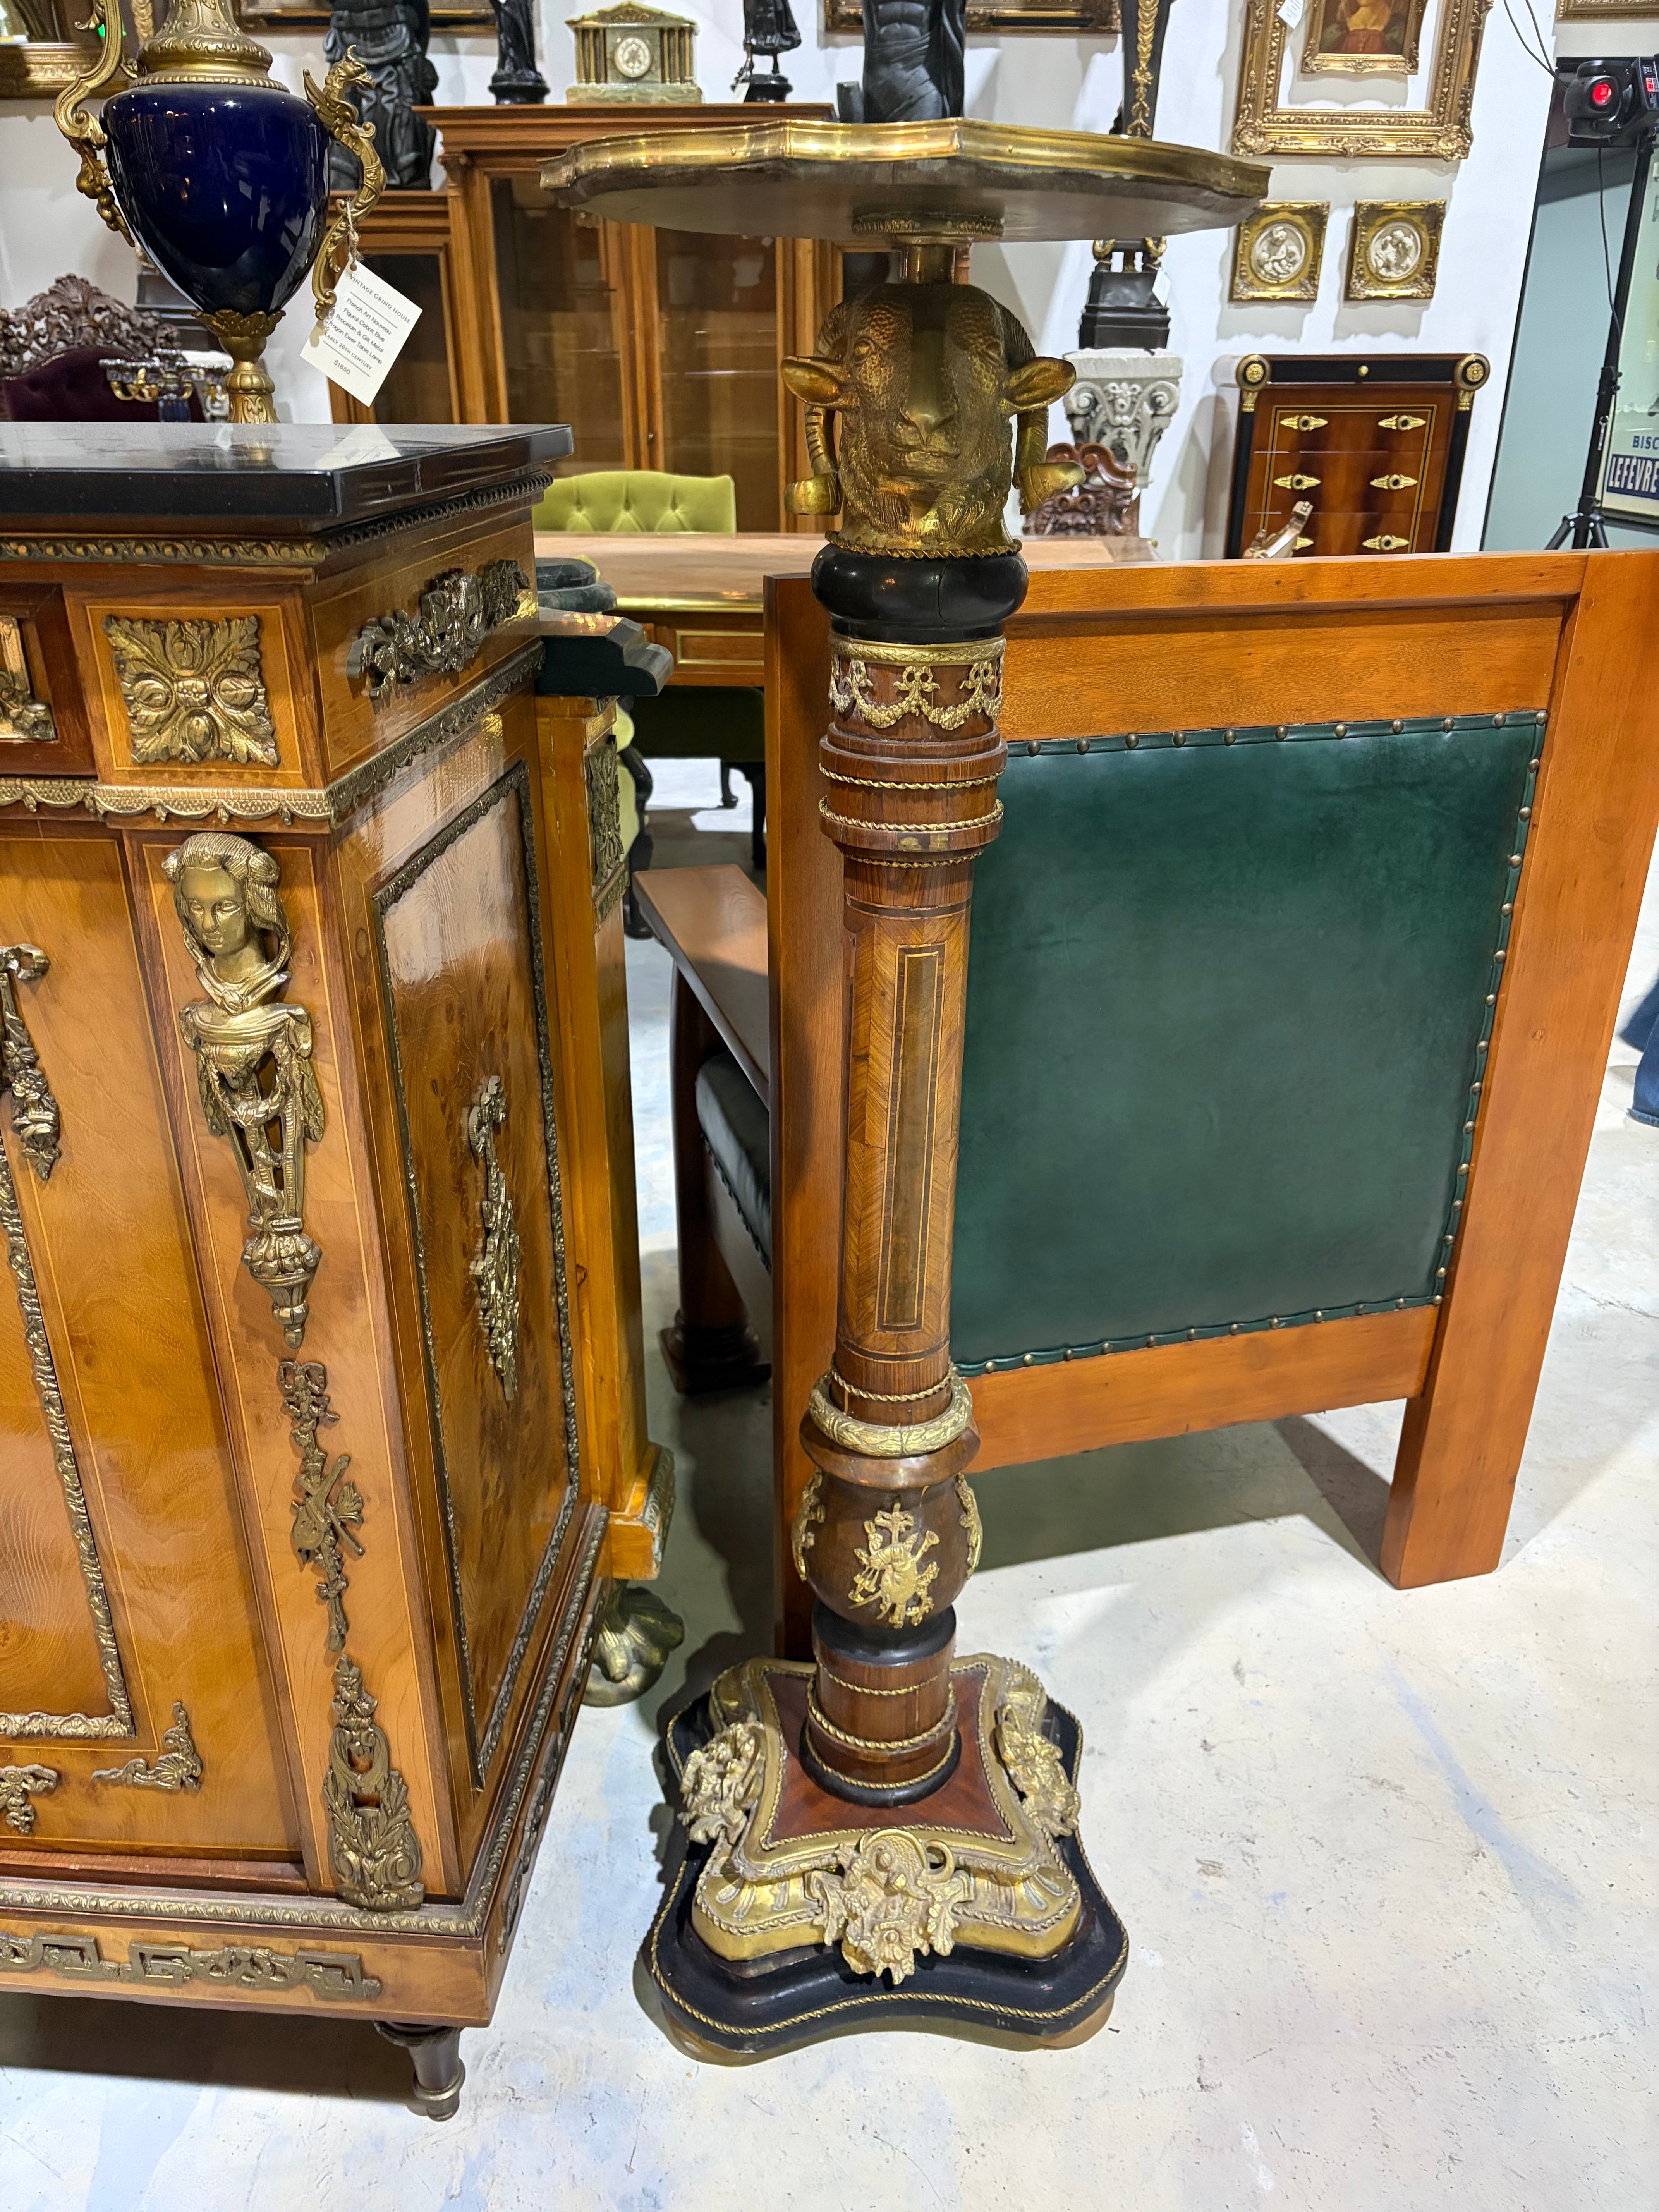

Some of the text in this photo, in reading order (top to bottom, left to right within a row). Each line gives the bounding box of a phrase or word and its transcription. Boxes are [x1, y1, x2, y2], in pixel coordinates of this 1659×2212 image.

[347, 298, 392, 335] French Art Nouveau
[350, 274, 411, 324] VINTAGE GRIND HOUSE
[335, 314, 356, 333] Procelain
[362, 334, 370, 343] Gilt
[371, 340, 384, 353] Metal
[343, 307, 385, 342] Figural Cobalt Blue
[339, 343, 351, 354] 20TH
[351, 353, 372, 370] CENTURY
[344, 332, 356, 344] Ewer
[357, 342, 369, 354] Table
[369, 352, 382, 364] Lamp
[334, 359, 351, 374] $1850
